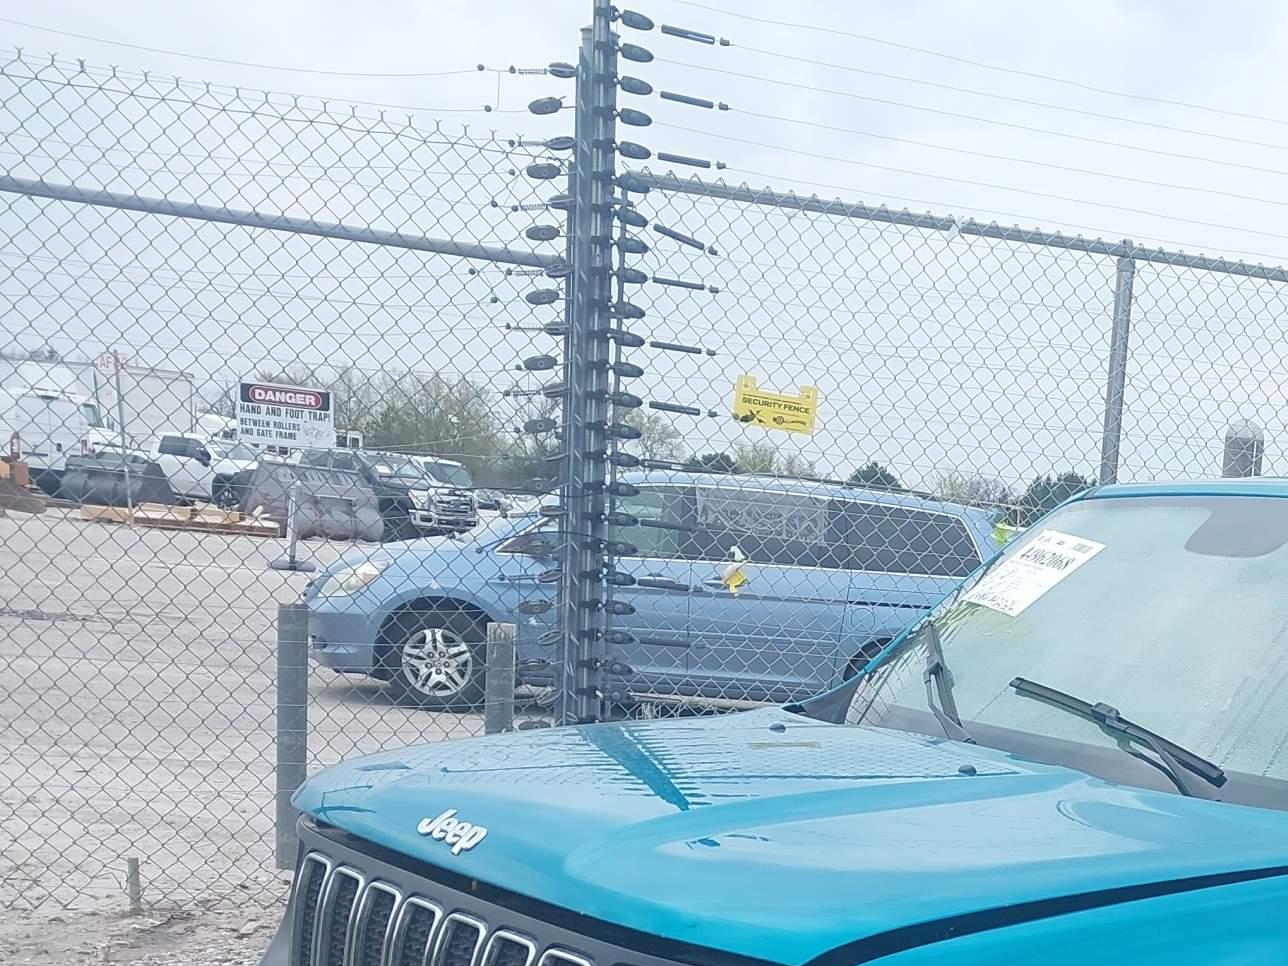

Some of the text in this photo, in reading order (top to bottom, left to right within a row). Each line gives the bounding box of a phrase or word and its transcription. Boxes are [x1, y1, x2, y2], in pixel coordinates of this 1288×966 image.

[254, 389, 316, 406] DANGER
[742, 396, 809, 414] SECURITY FENCE
[240, 403, 261, 414] HAND
[266, 406, 281, 416] AND
[285, 408, 304, 419] FOOT
[240, 417, 300, 431] BETWEEN ROLLERS
[240, 427, 296, 440] AND GATE FRAME
[417, 808, 489, 857] Jeep
